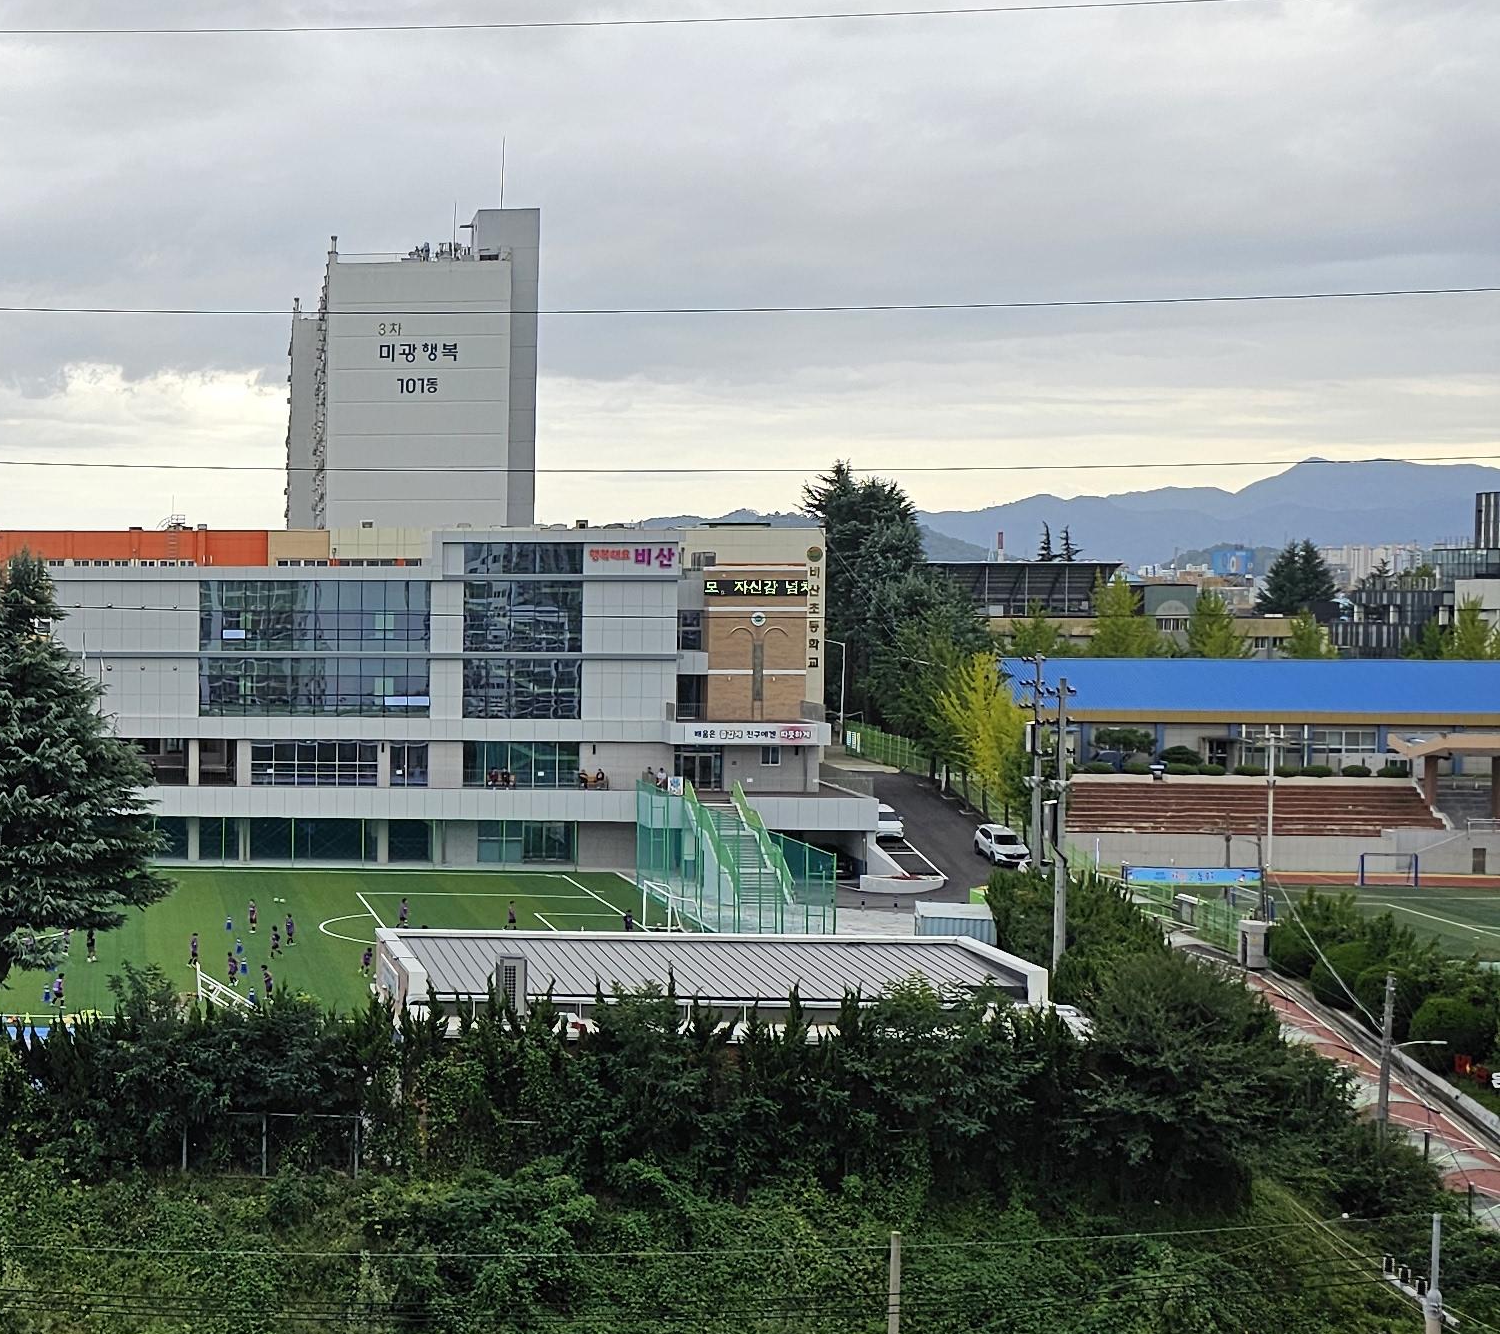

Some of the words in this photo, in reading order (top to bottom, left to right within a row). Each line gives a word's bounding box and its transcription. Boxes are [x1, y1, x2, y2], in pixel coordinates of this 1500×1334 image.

[378, 322, 402, 336] 3차
[379, 342, 458, 363] 미광행복
[396, 377, 438, 394] 101동
[635, 547, 675, 568] 비산
[733, 579, 779, 595] 자신감
[808, 566, 820, 668] 비산초등학교
